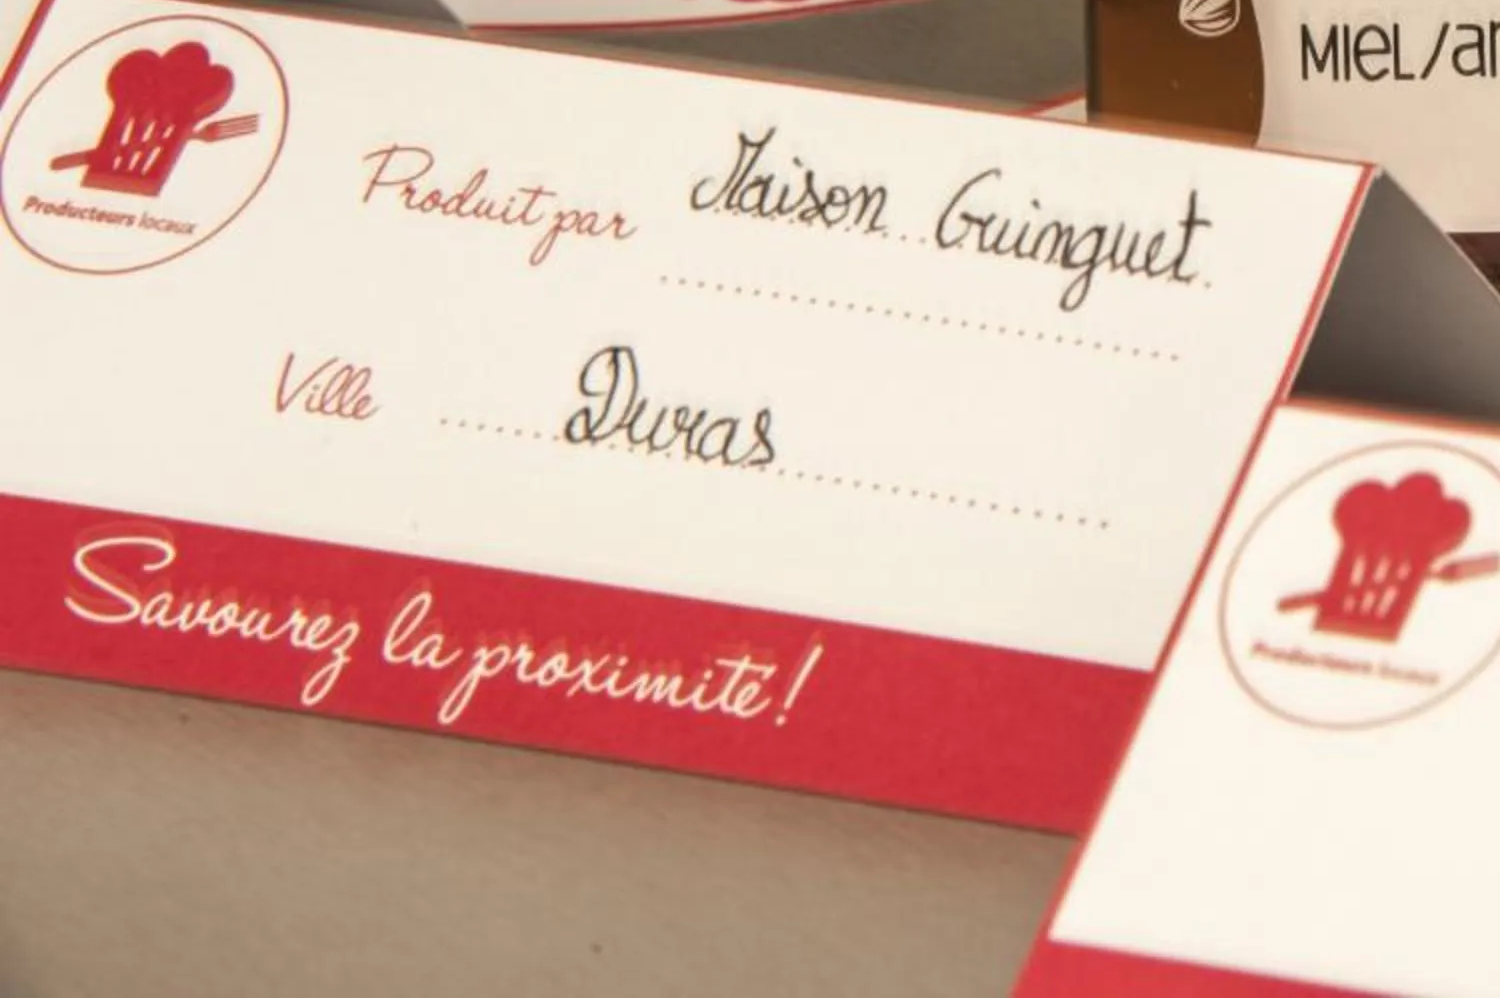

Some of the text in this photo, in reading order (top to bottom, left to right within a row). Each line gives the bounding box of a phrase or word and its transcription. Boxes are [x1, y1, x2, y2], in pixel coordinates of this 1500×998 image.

[362, 142, 638, 267] Produit par
[690, 127, 888, 234] Maison
[275, 352, 382, 421] Ville
[563, 345, 776, 467] Duras
[64, 536, 359, 707] Savourez
[383, 592, 459, 673] la
